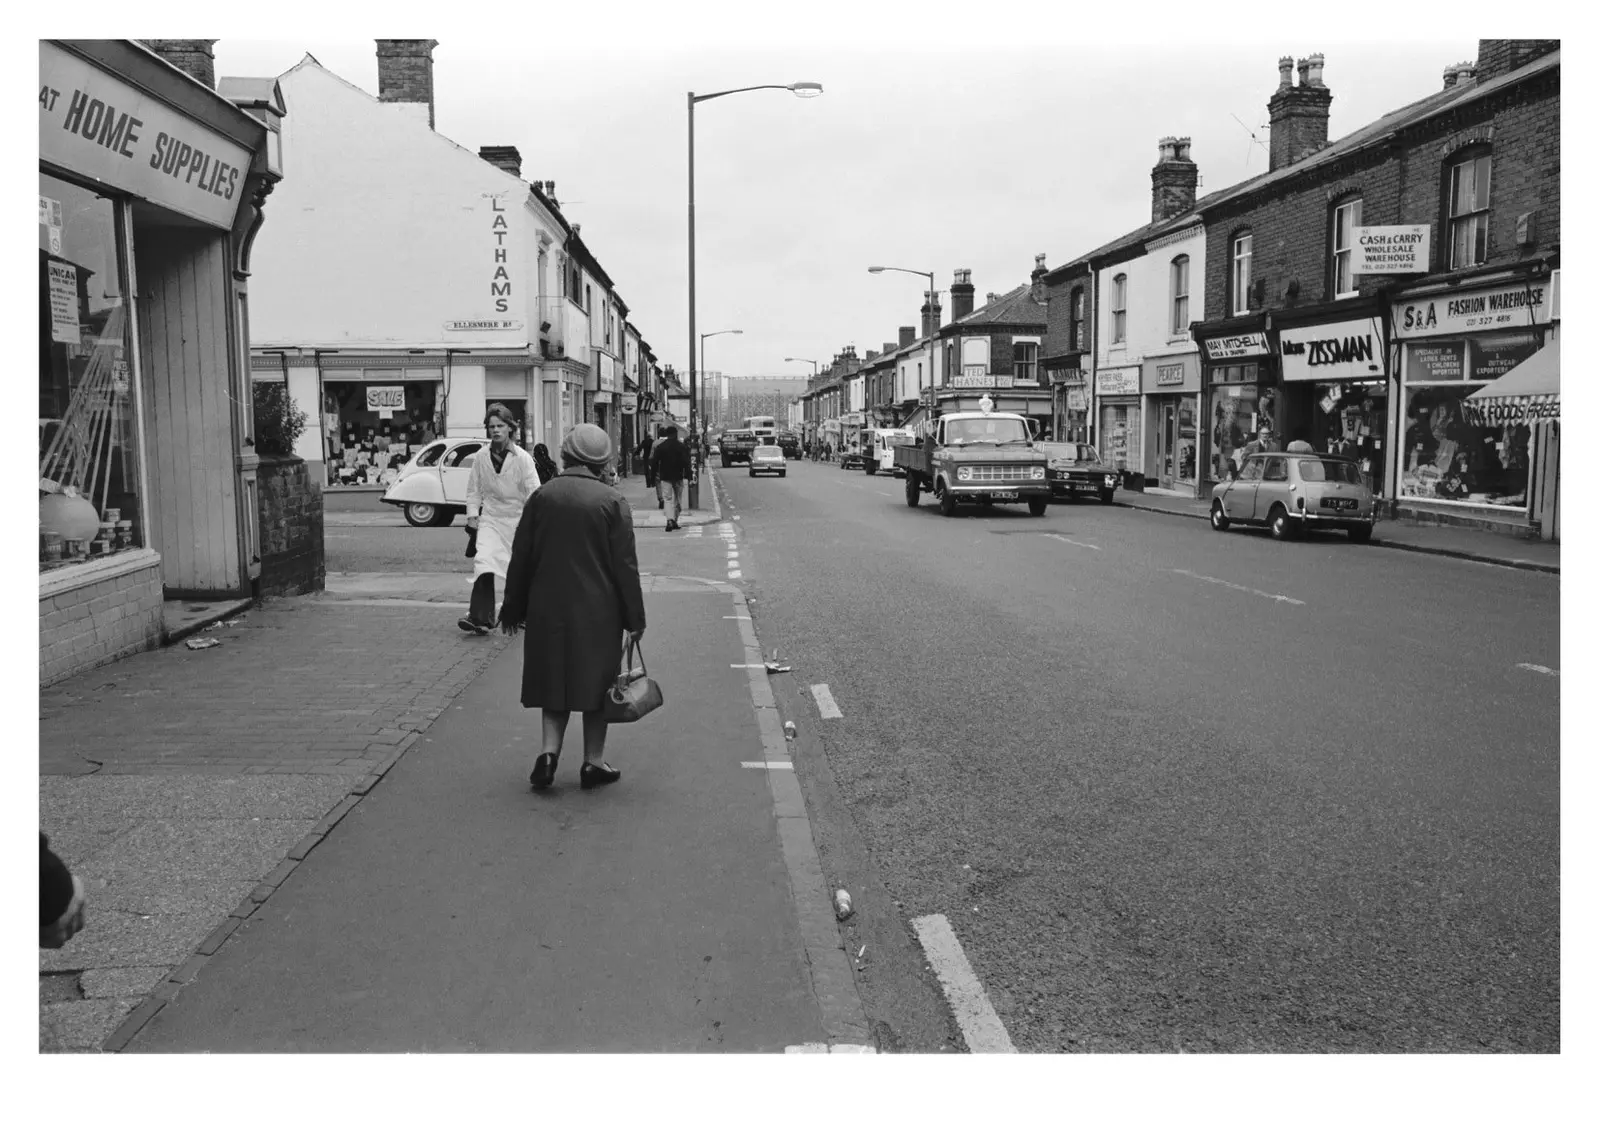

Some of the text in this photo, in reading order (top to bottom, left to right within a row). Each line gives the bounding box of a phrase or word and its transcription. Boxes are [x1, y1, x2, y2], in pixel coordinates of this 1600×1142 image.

[39, 86, 240, 201] AT HOME SUPPLIES
[1360, 235, 1386, 245] CASH
[1393, 234, 1423, 244] CARRY
[491, 198, 511, 313] LATHAMS
[1364, 245, 1414, 253] WHOLESALE
[1365, 254, 1416, 262] WAREHOUSE
[50, 266, 77, 282] UNICAN
[1404, 288, 1544, 330] S & A FASHION WAREHOUSE
[1479, 317, 1493, 325] 327
[1206, 335, 1260, 350] MAY MITCHELL
[1306, 334, 1374, 366] ZISSMAN
[1415, 348, 1442, 356] SPECIALIST
[967, 368, 985, 377] TED
[956, 377, 993, 387] HAYNES
[368, 390, 404, 407] SALE
[1487, 403, 1527, 420] FOODS
